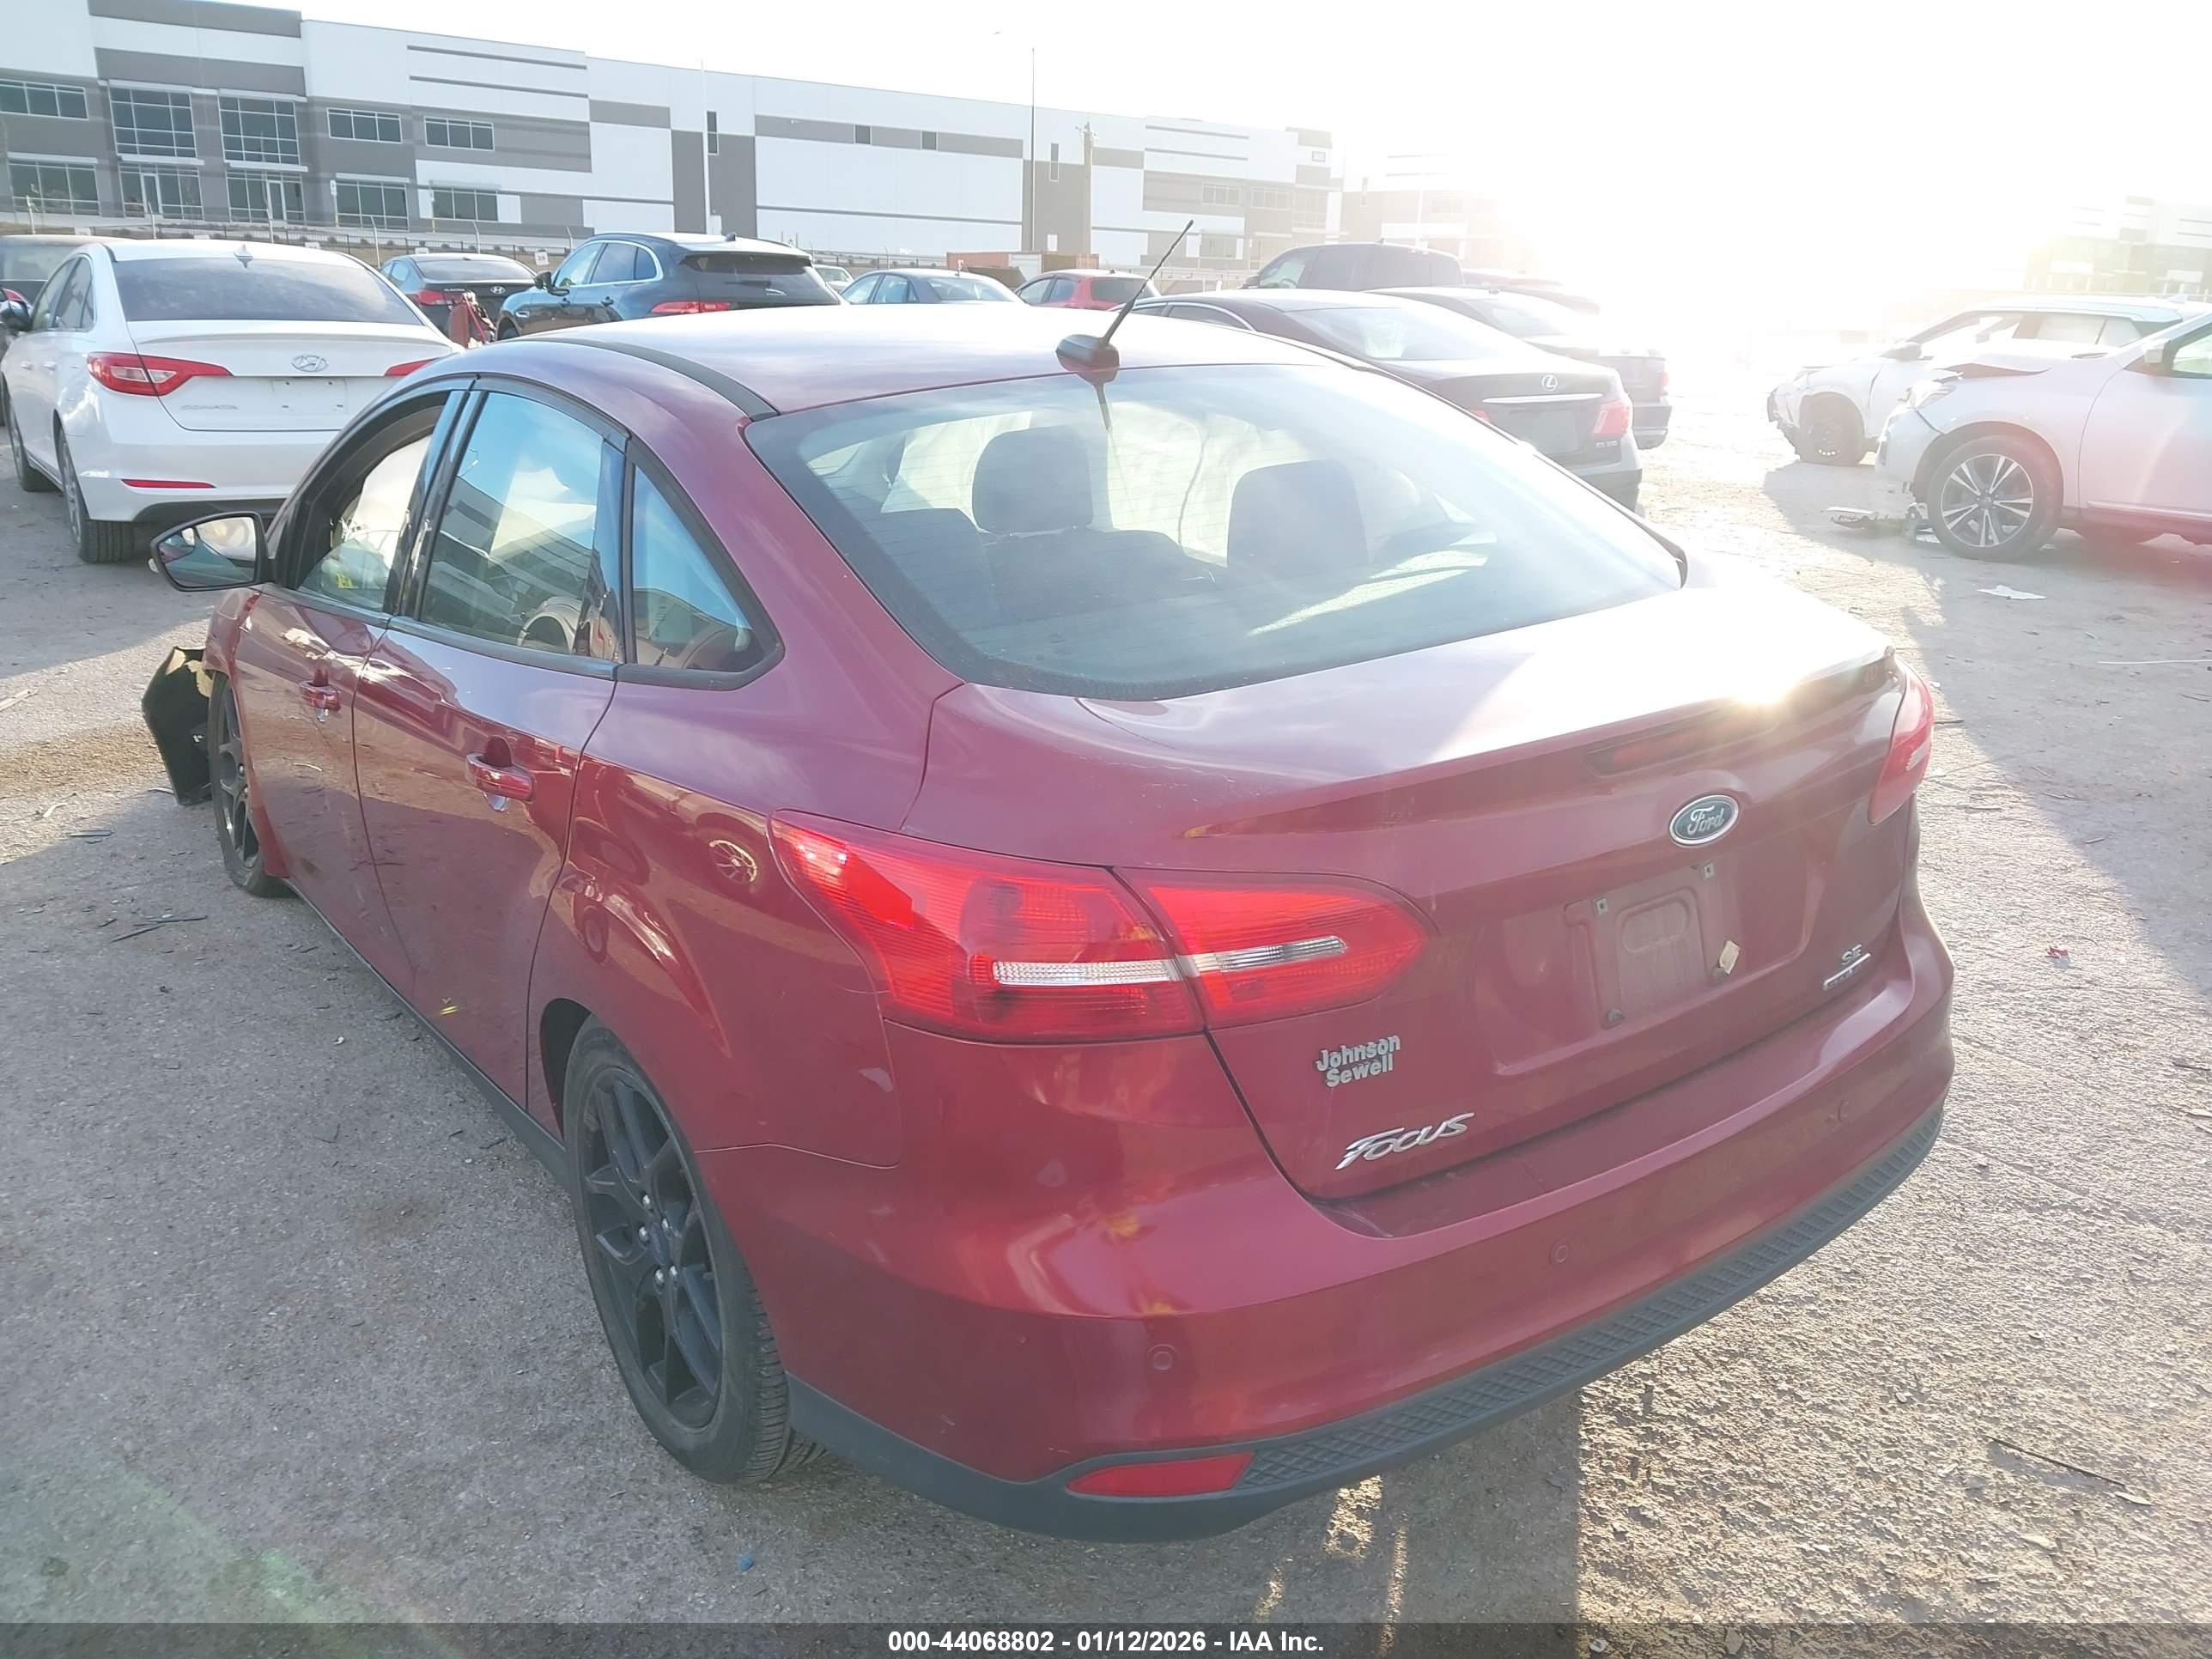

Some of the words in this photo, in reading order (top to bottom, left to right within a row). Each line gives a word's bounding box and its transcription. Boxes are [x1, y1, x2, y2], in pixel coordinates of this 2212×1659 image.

[1686, 805, 1725, 835] Ford
[1316, 1034, 1401, 1073] Johnson
[1325, 1053, 1395, 1088] Sewell
